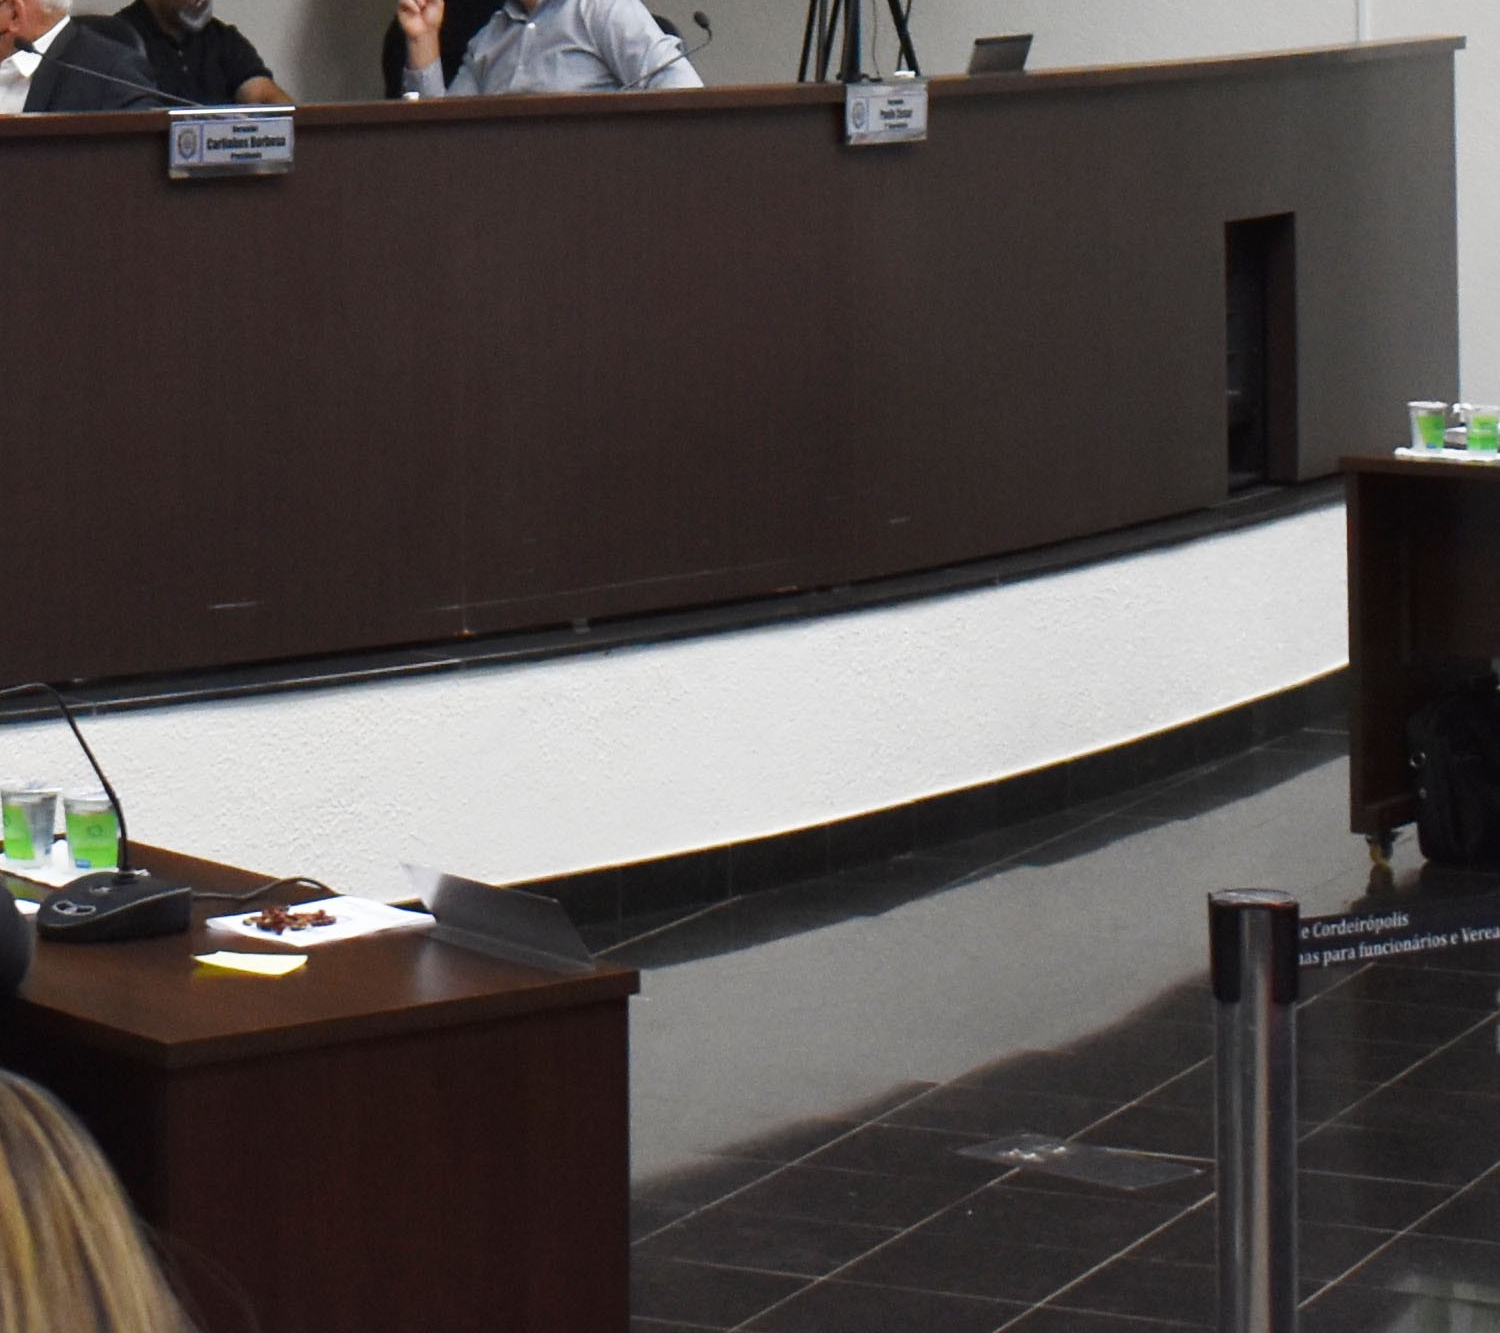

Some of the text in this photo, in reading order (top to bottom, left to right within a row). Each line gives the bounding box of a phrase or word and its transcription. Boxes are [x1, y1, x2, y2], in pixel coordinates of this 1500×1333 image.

[1313, 910, 1410, 941] Cordeirópolis
[1322, 943, 1356, 967] para
[1359, 932, 1449, 961] funcionários
